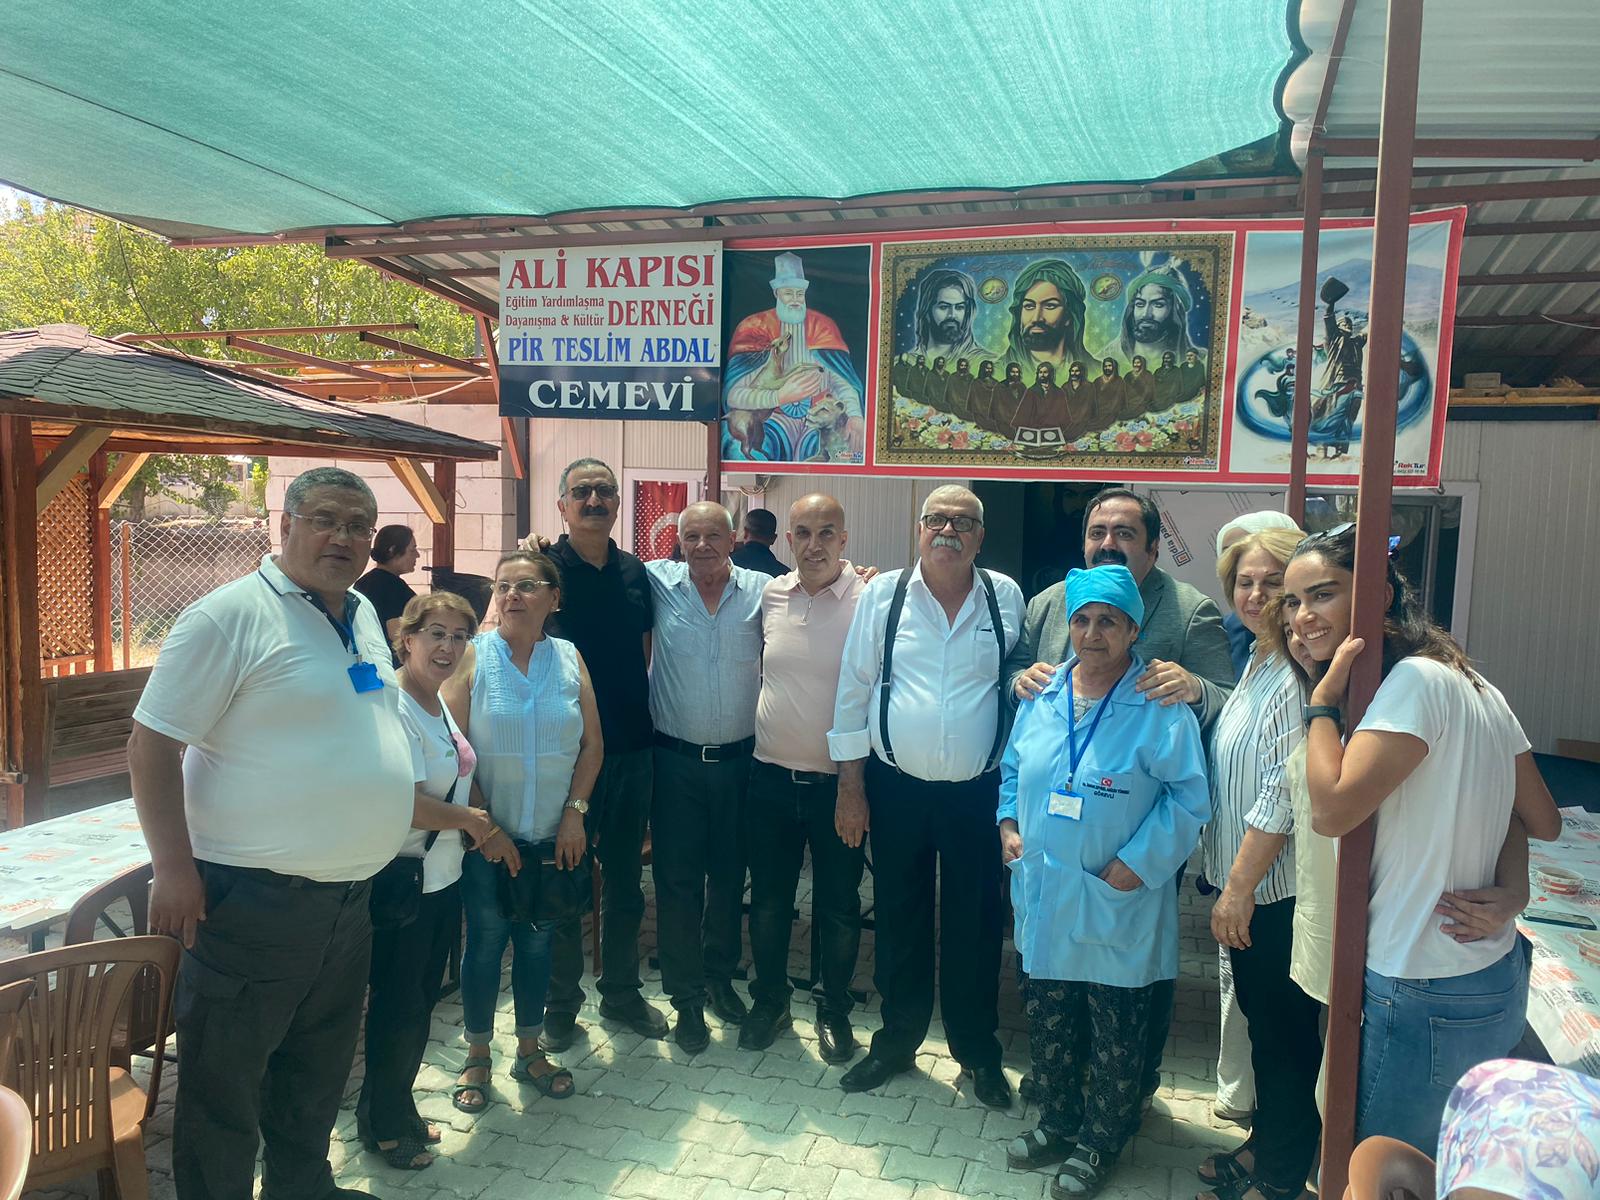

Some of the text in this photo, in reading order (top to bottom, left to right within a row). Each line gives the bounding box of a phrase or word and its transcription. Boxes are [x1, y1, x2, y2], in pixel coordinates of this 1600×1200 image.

[506, 249, 715, 289] ALİ KAPISI
[505, 295, 604, 311] Eğitim Yardımlaşma
[608, 293, 714, 326] DERNEĞİ
[505, 313, 604, 329] Dayanışma & Kültür
[508, 332, 715, 363] PİR TESLİM ABDAL
[528, 375, 695, 411] CEMEVİ
